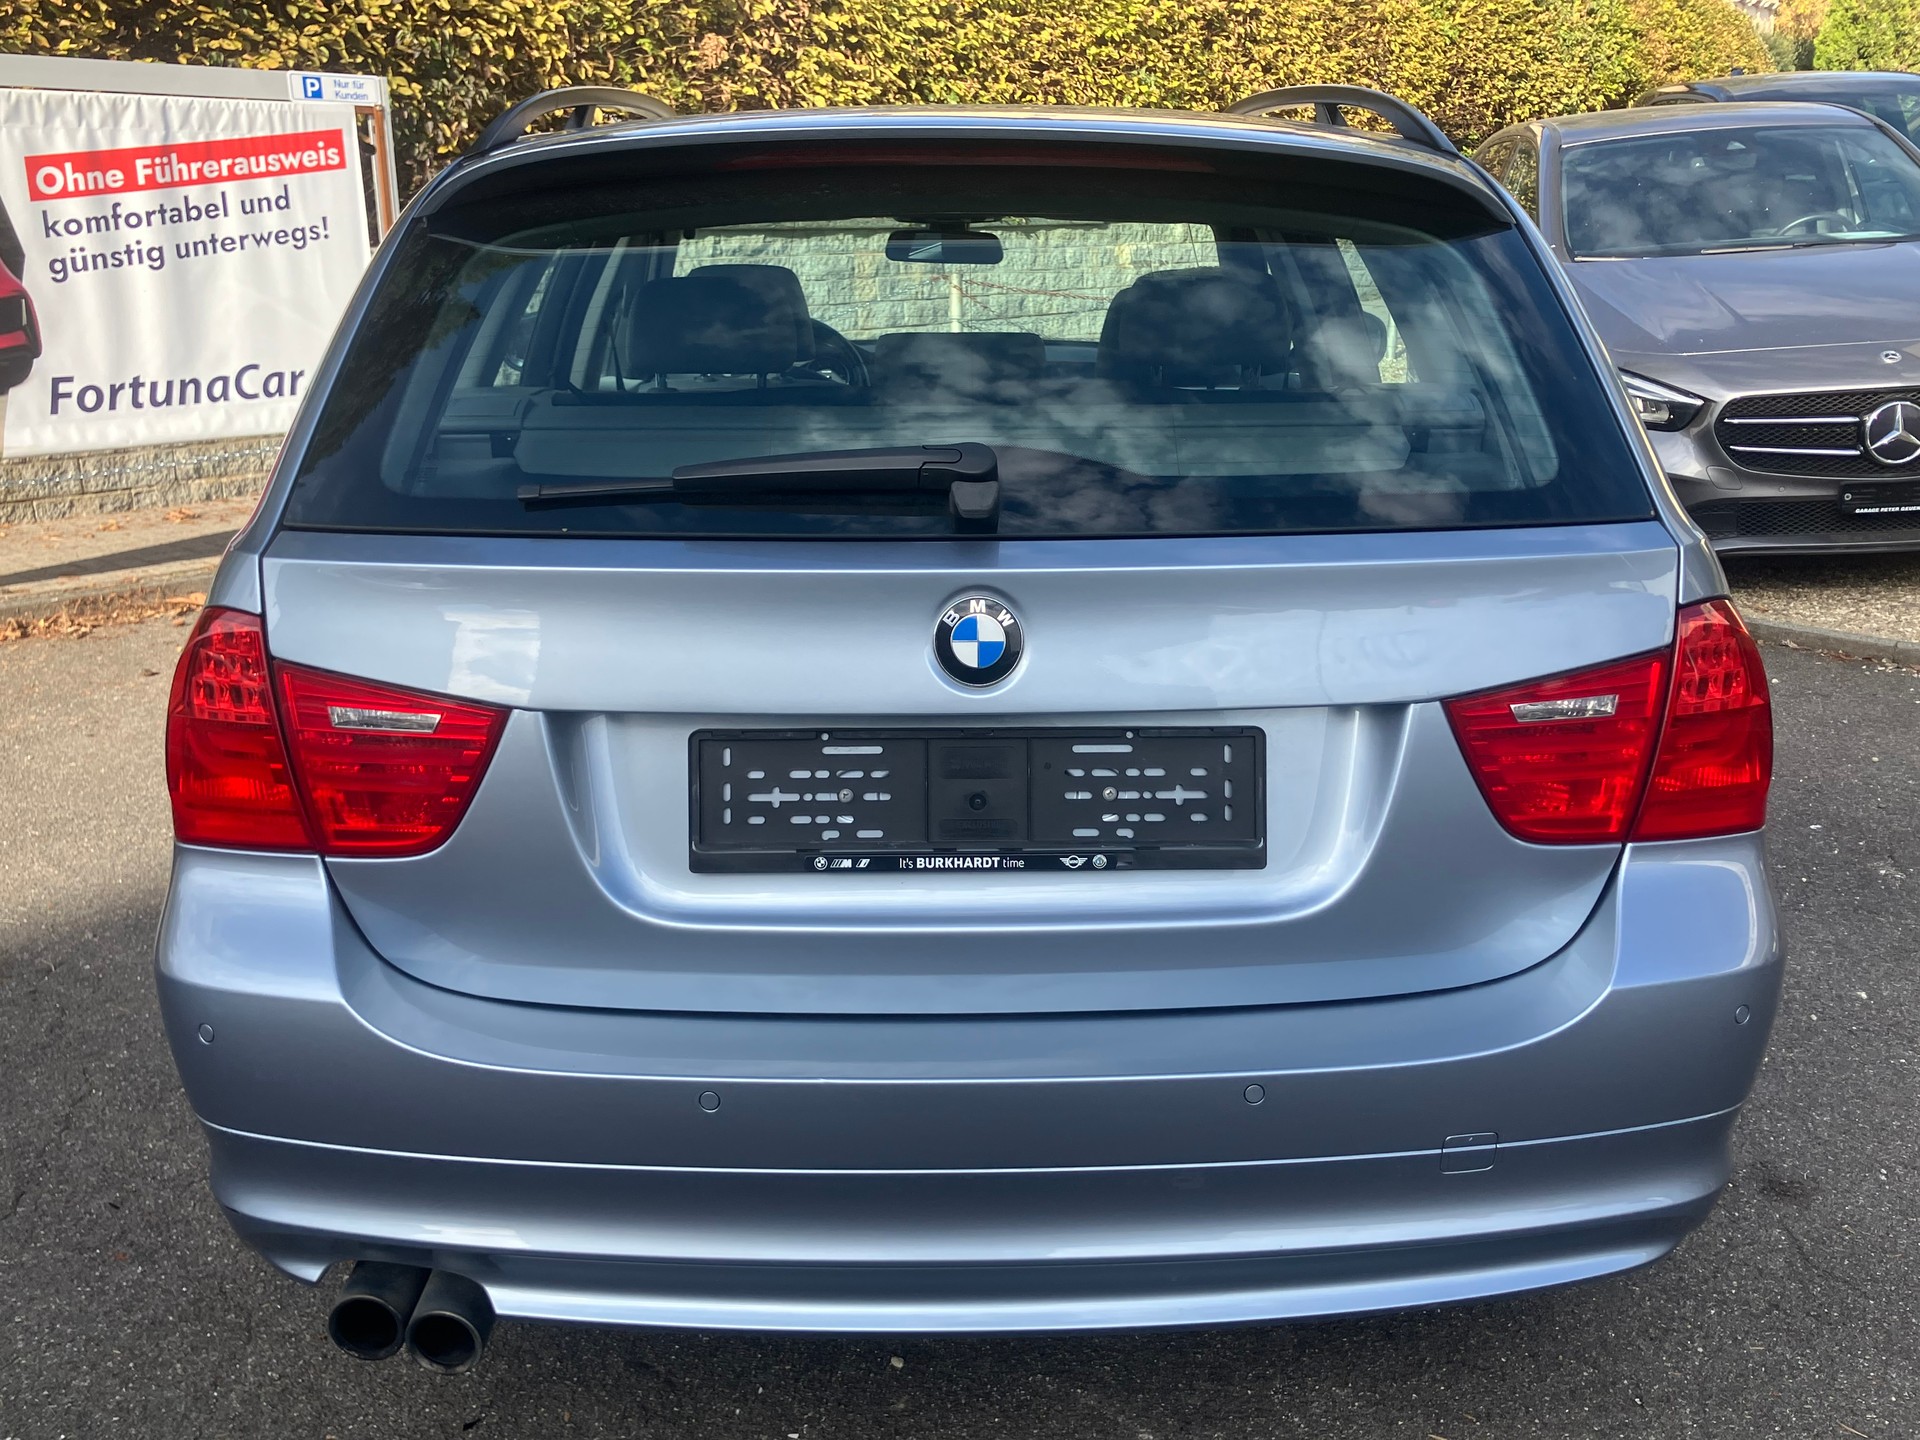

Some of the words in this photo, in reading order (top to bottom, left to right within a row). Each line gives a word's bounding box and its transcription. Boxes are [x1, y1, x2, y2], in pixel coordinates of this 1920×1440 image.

[305, 78, 320, 98] P
[333, 79, 350, 89] Nur
[352, 79, 365, 90] für
[335, 90, 369, 101] Kunden
[35, 161, 125, 196] Ohne
[134, 141, 341, 186] Führerausweis
[41, 191, 230, 238] komfortabel
[240, 184, 292, 215] und
[48, 240, 166, 283] günstig
[175, 216, 331, 260] unterwegs!
[50, 363, 306, 415] FortunaCar
[942, 599, 1015, 628] BMW
[899, 857, 914, 868] It's
[916, 856, 1001, 869] BURKHARDT
[1002, 857, 1025, 868] time
